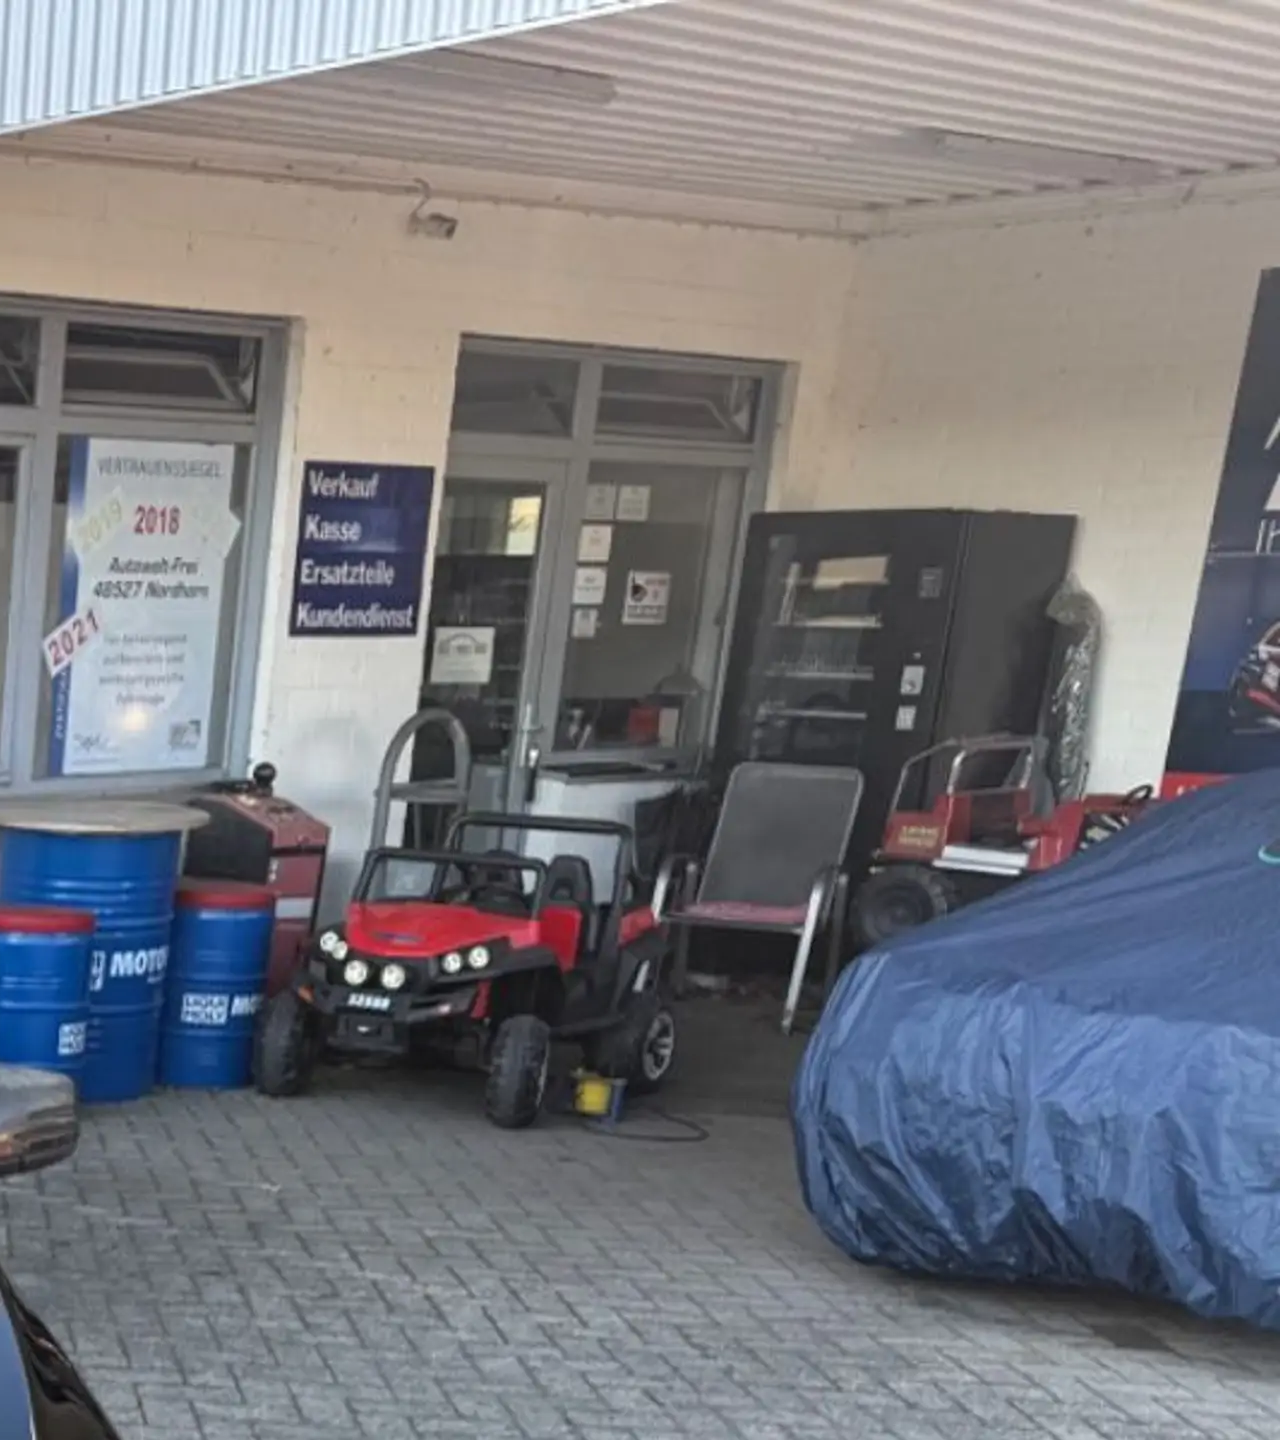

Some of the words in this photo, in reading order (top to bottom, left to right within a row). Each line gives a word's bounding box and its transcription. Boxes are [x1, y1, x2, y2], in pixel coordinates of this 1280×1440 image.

[309, 469, 380, 499] Verkauf
[133, 504, 181, 535] 2018
[305, 513, 363, 543] Kasse
[300, 558, 395, 588] Ersatzteile
[296, 601, 415, 630] Kundendienst
[47, 608, 99, 666] 2021
